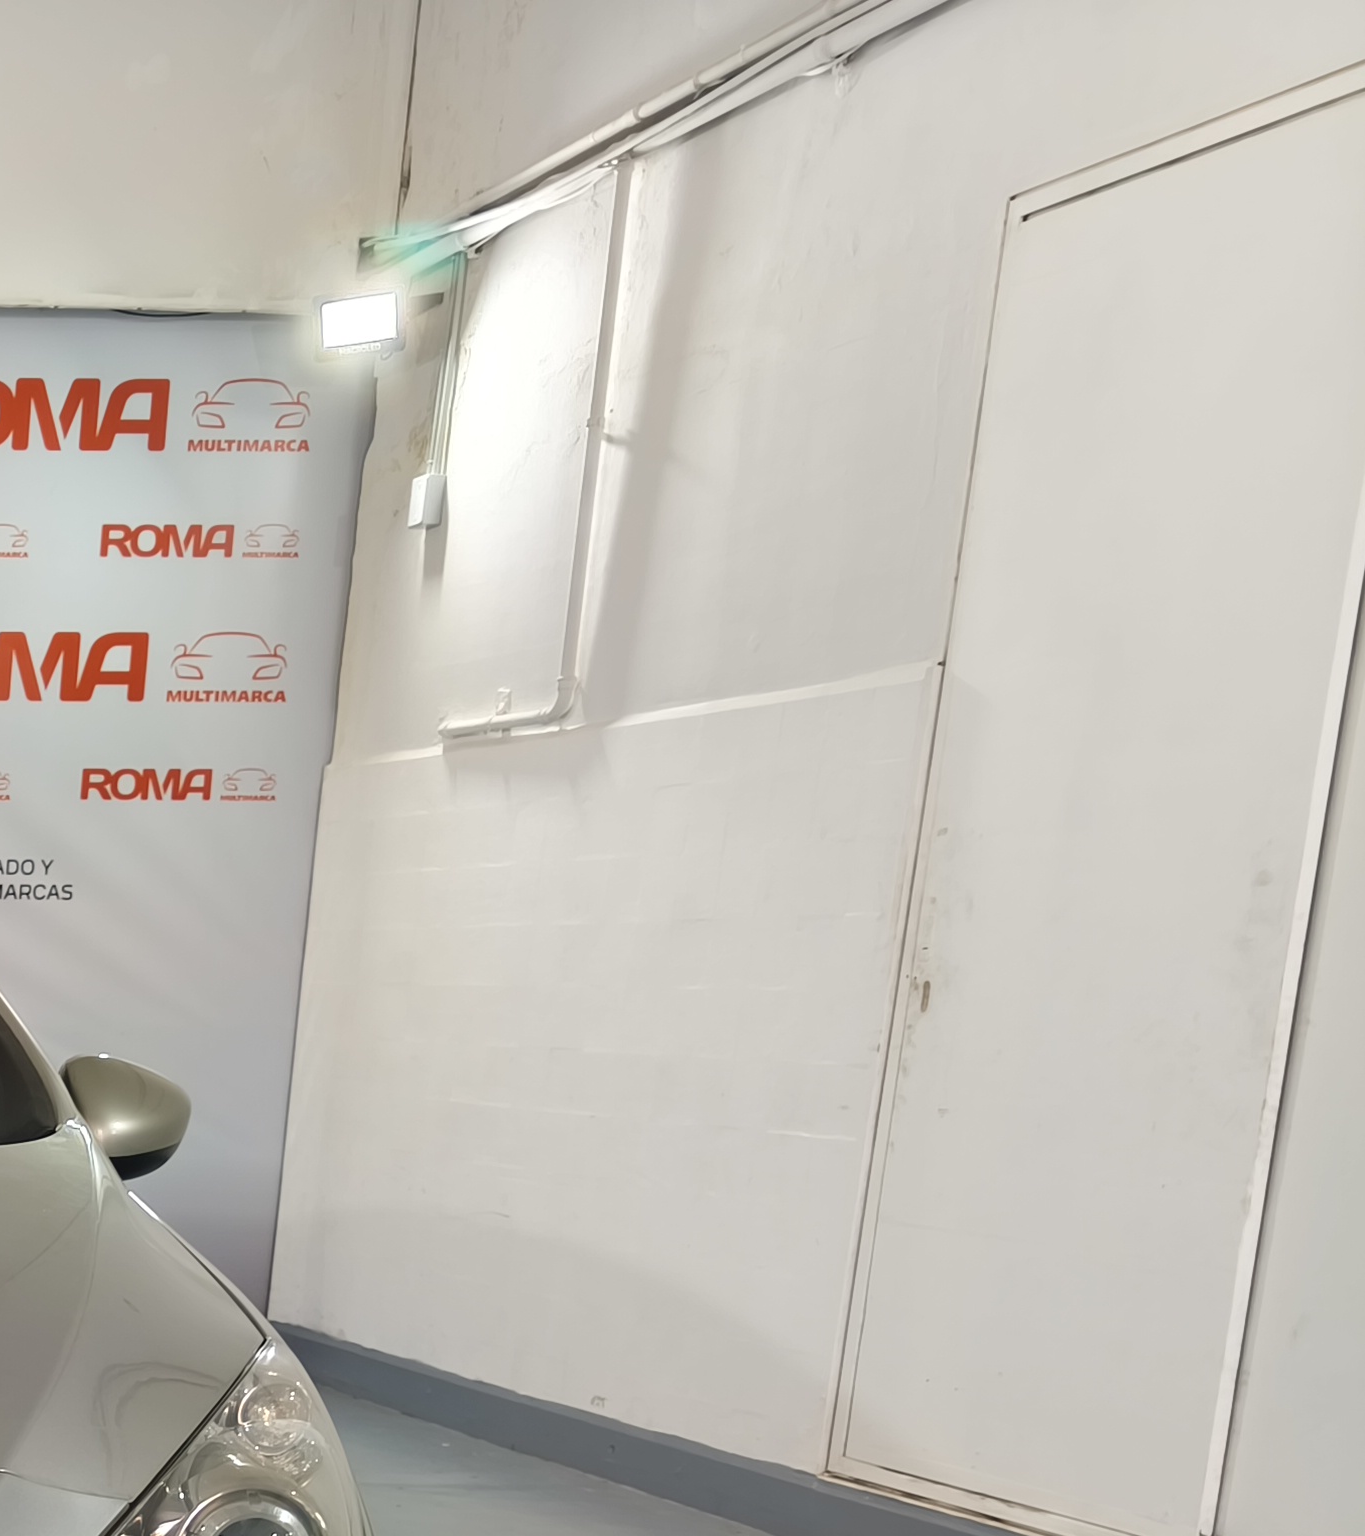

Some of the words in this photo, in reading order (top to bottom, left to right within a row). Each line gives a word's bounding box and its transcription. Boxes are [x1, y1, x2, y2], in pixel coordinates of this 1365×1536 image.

[186, 439, 310, 453] MULTIMARCA
[100, 524, 235, 559] ROMA
[165, 691, 287, 704] MULTIMARCA
[80, 768, 213, 802] ROMA
[41, 860, 54, 876] Y
